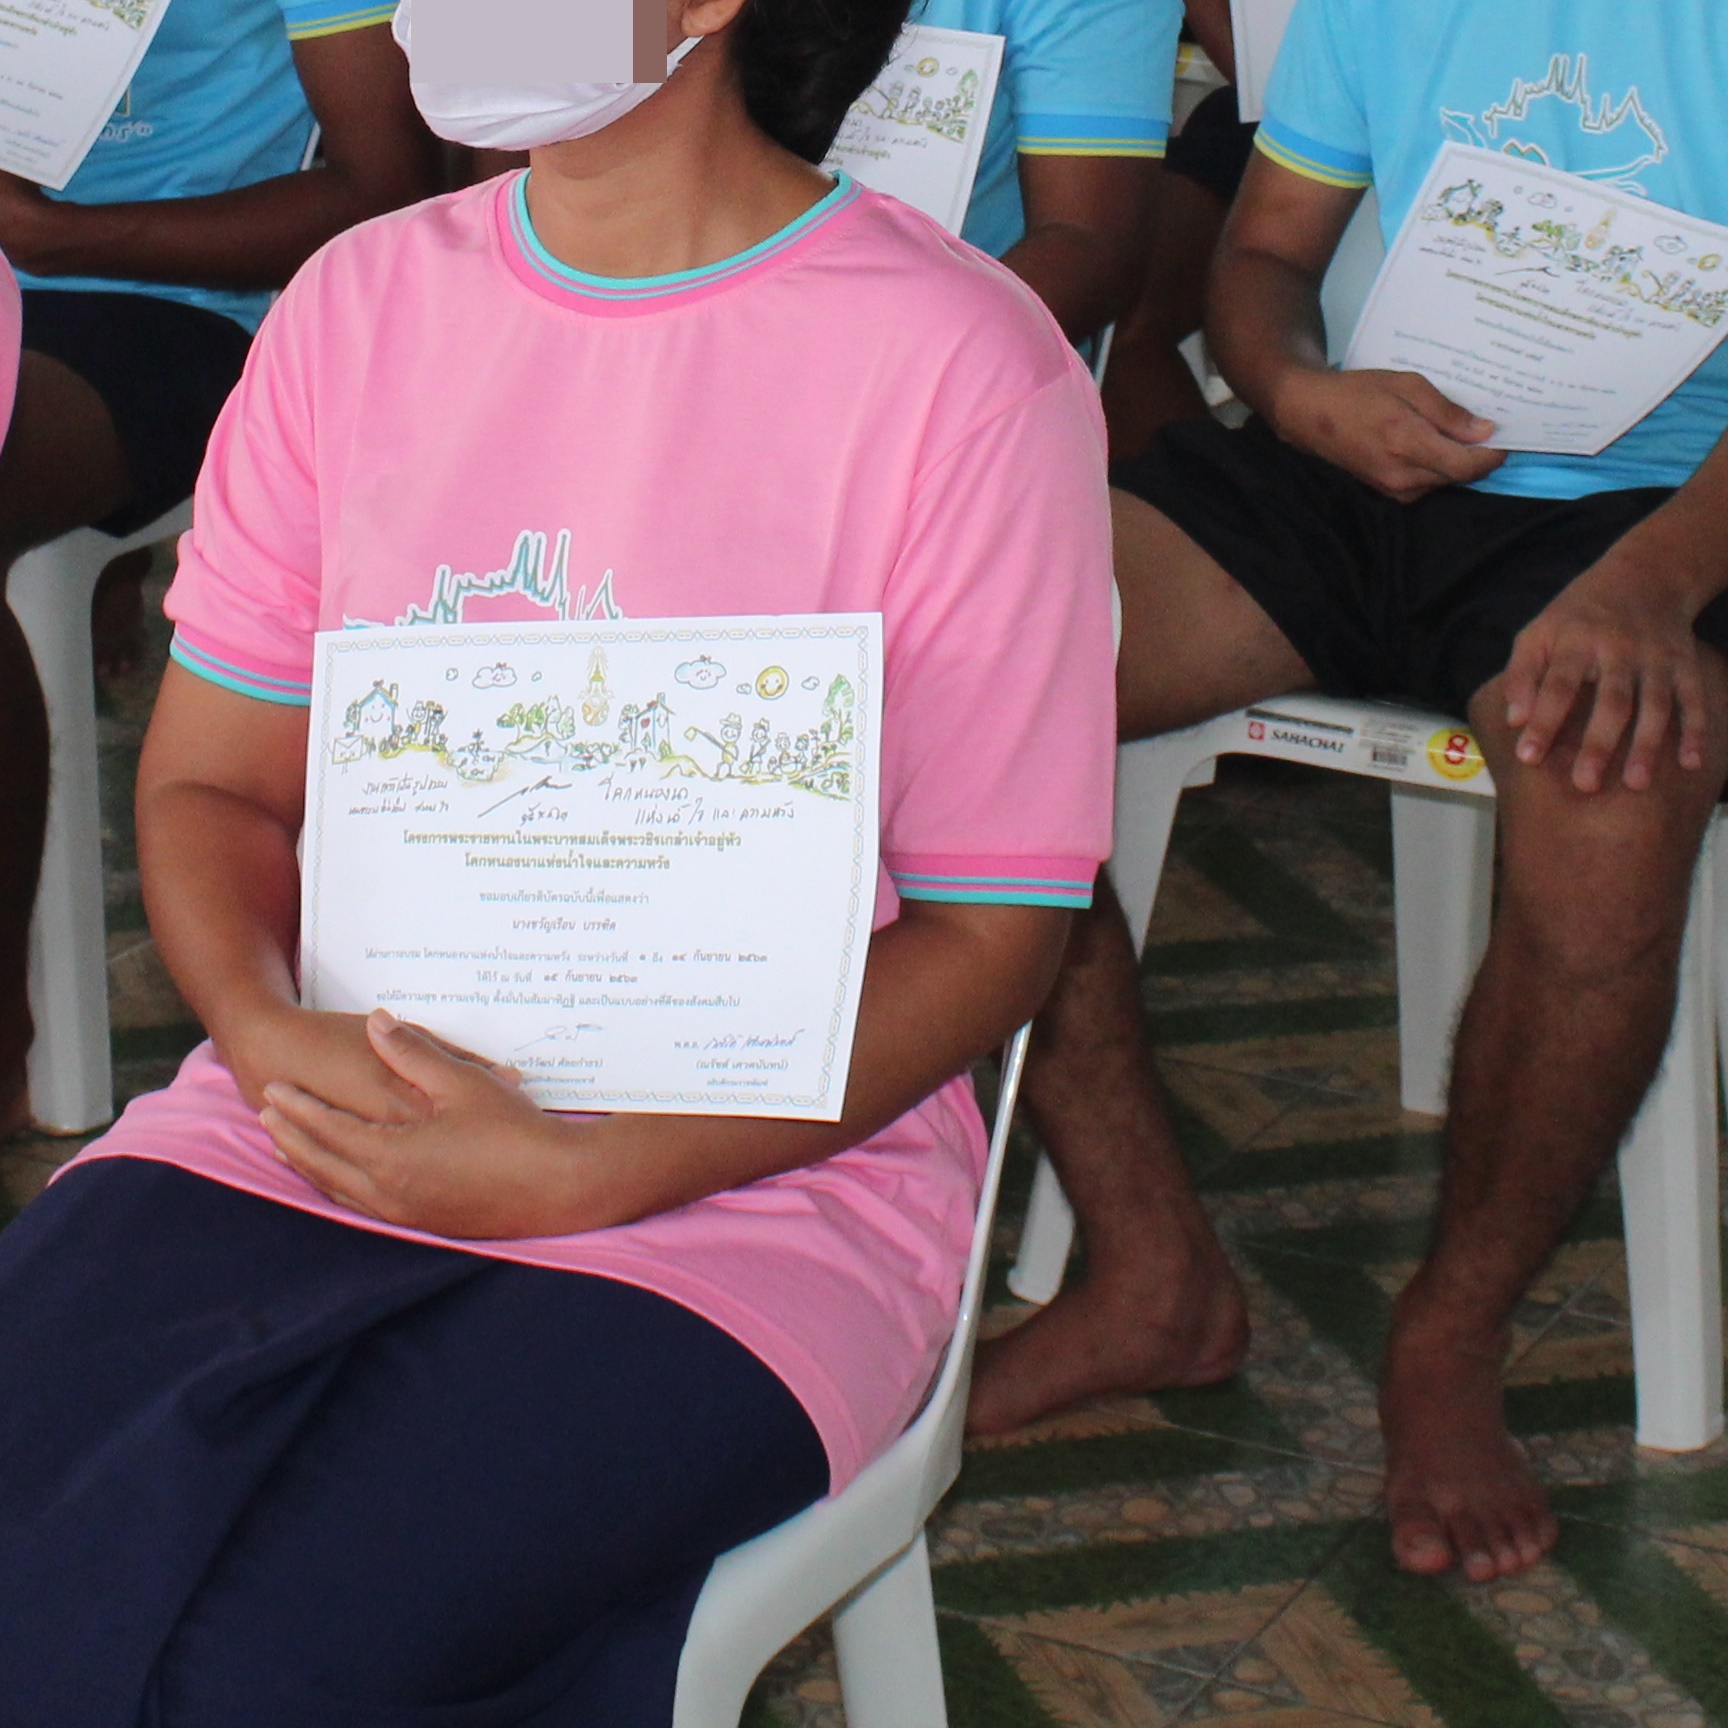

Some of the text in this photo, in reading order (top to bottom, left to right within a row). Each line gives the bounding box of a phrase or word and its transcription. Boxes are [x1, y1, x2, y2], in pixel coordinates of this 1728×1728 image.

[1271, 728, 1347, 754] SAHACHAI
[464, 849, 670, 870] โคกหนองนาแห่งน้ำใจและความหวัง
